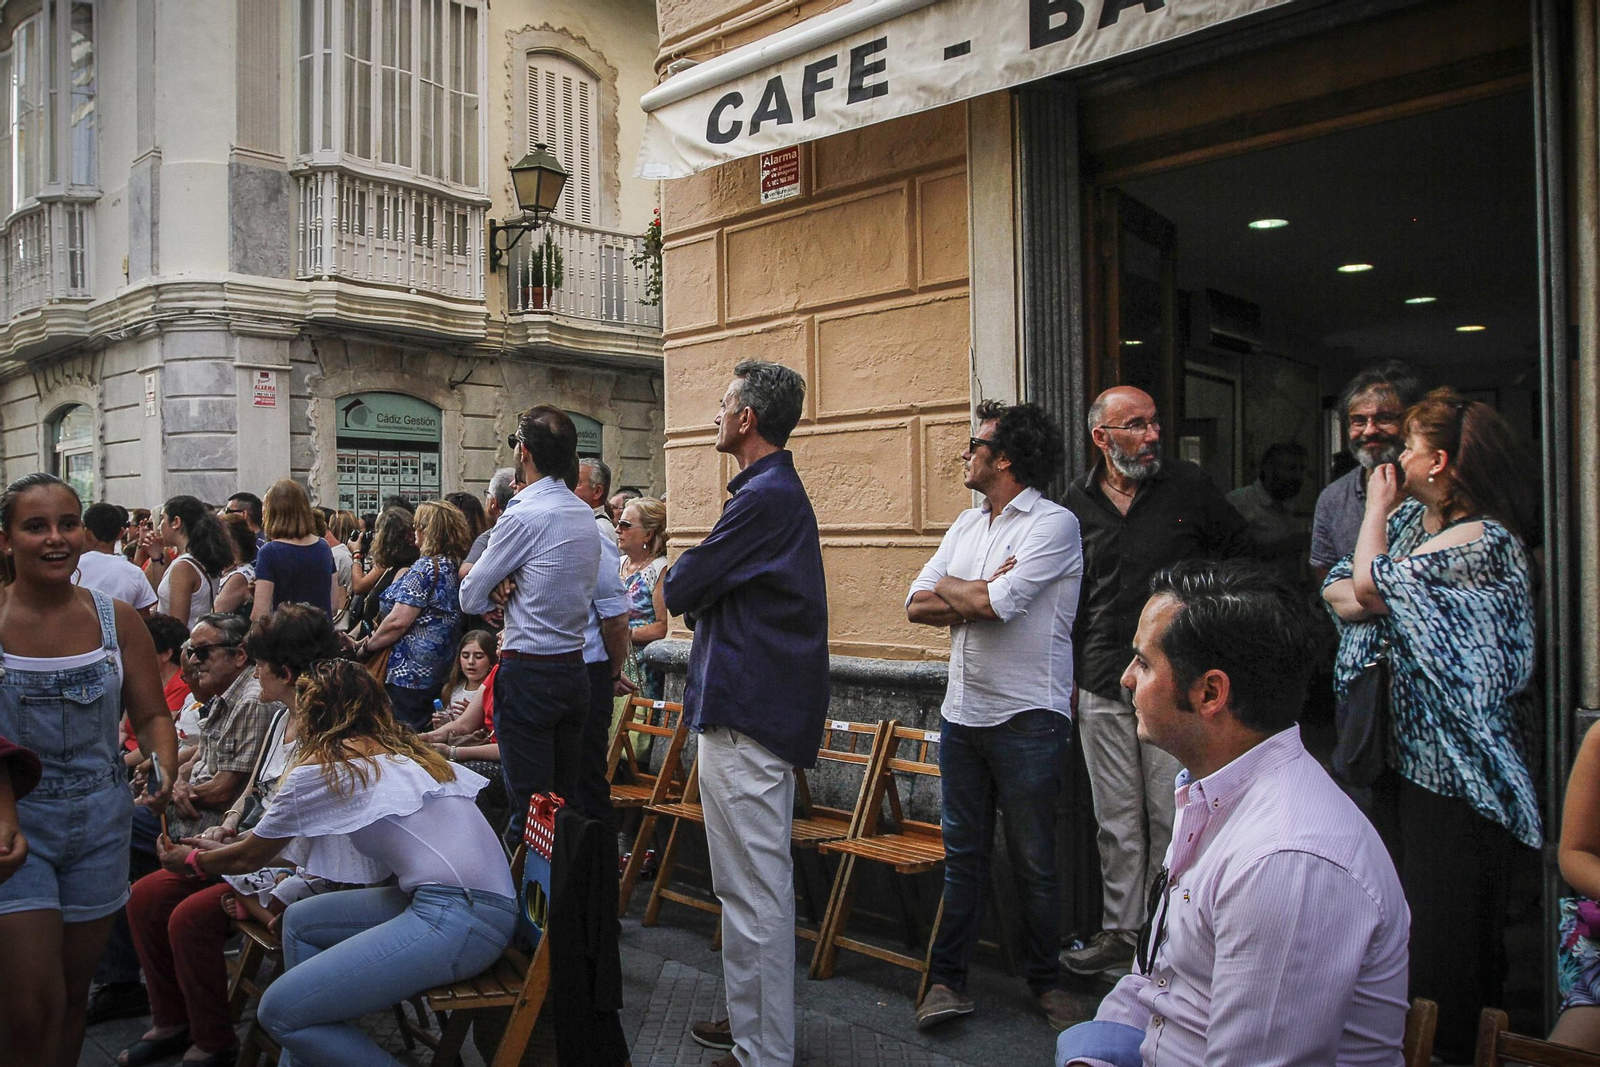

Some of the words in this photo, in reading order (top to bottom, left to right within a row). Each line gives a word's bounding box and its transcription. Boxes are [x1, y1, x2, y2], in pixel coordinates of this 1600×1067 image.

[706, 35, 889, 145] CAFE
[762, 151, 797, 168] Alarma
[376, 412, 401, 424] Cádiz
[403, 415, 436, 427] Gestión
[577, 431, 597, 439] estión
